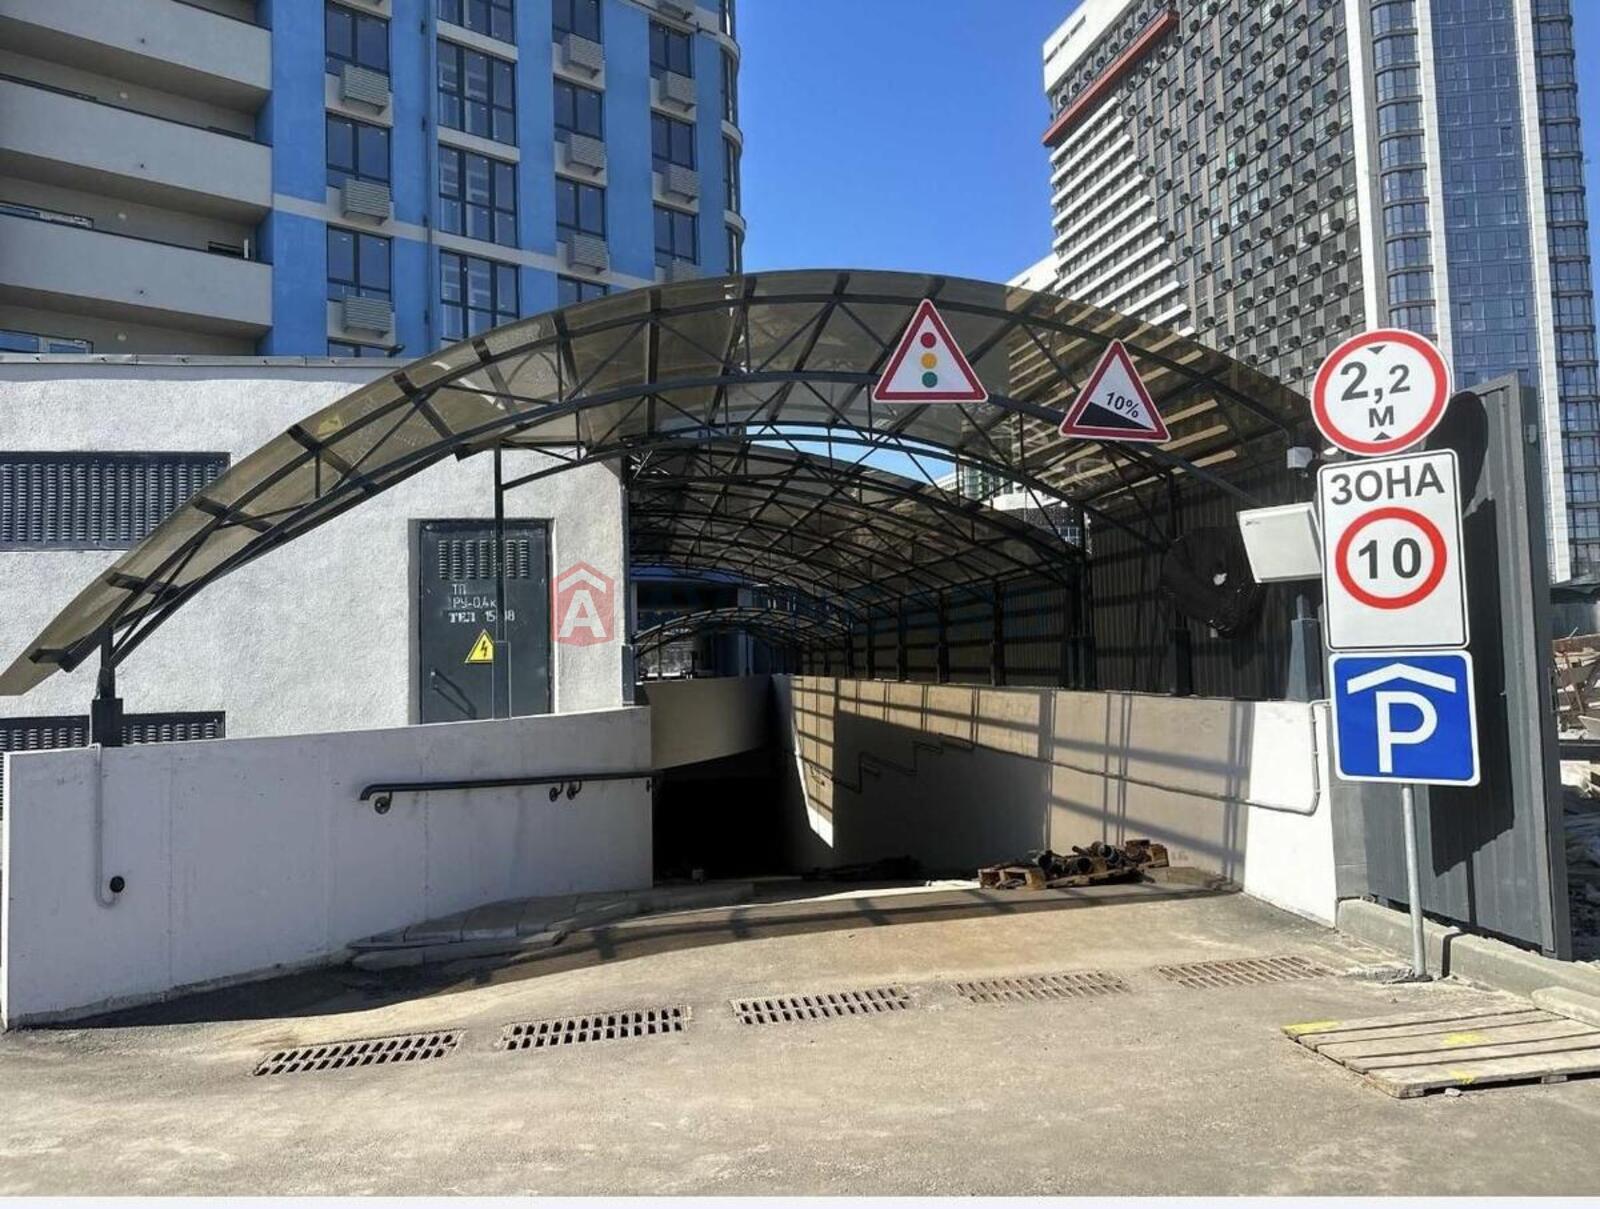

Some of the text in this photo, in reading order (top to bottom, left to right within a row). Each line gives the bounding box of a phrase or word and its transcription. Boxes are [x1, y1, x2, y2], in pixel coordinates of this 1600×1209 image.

[1340, 361, 1410, 404] 2,2
[1106, 391, 1139, 419] 10%
[1331, 462, 1445, 505] ЗОНА
[1359, 538, 1421, 579] 10
[1375, 691, 1438, 774] P
